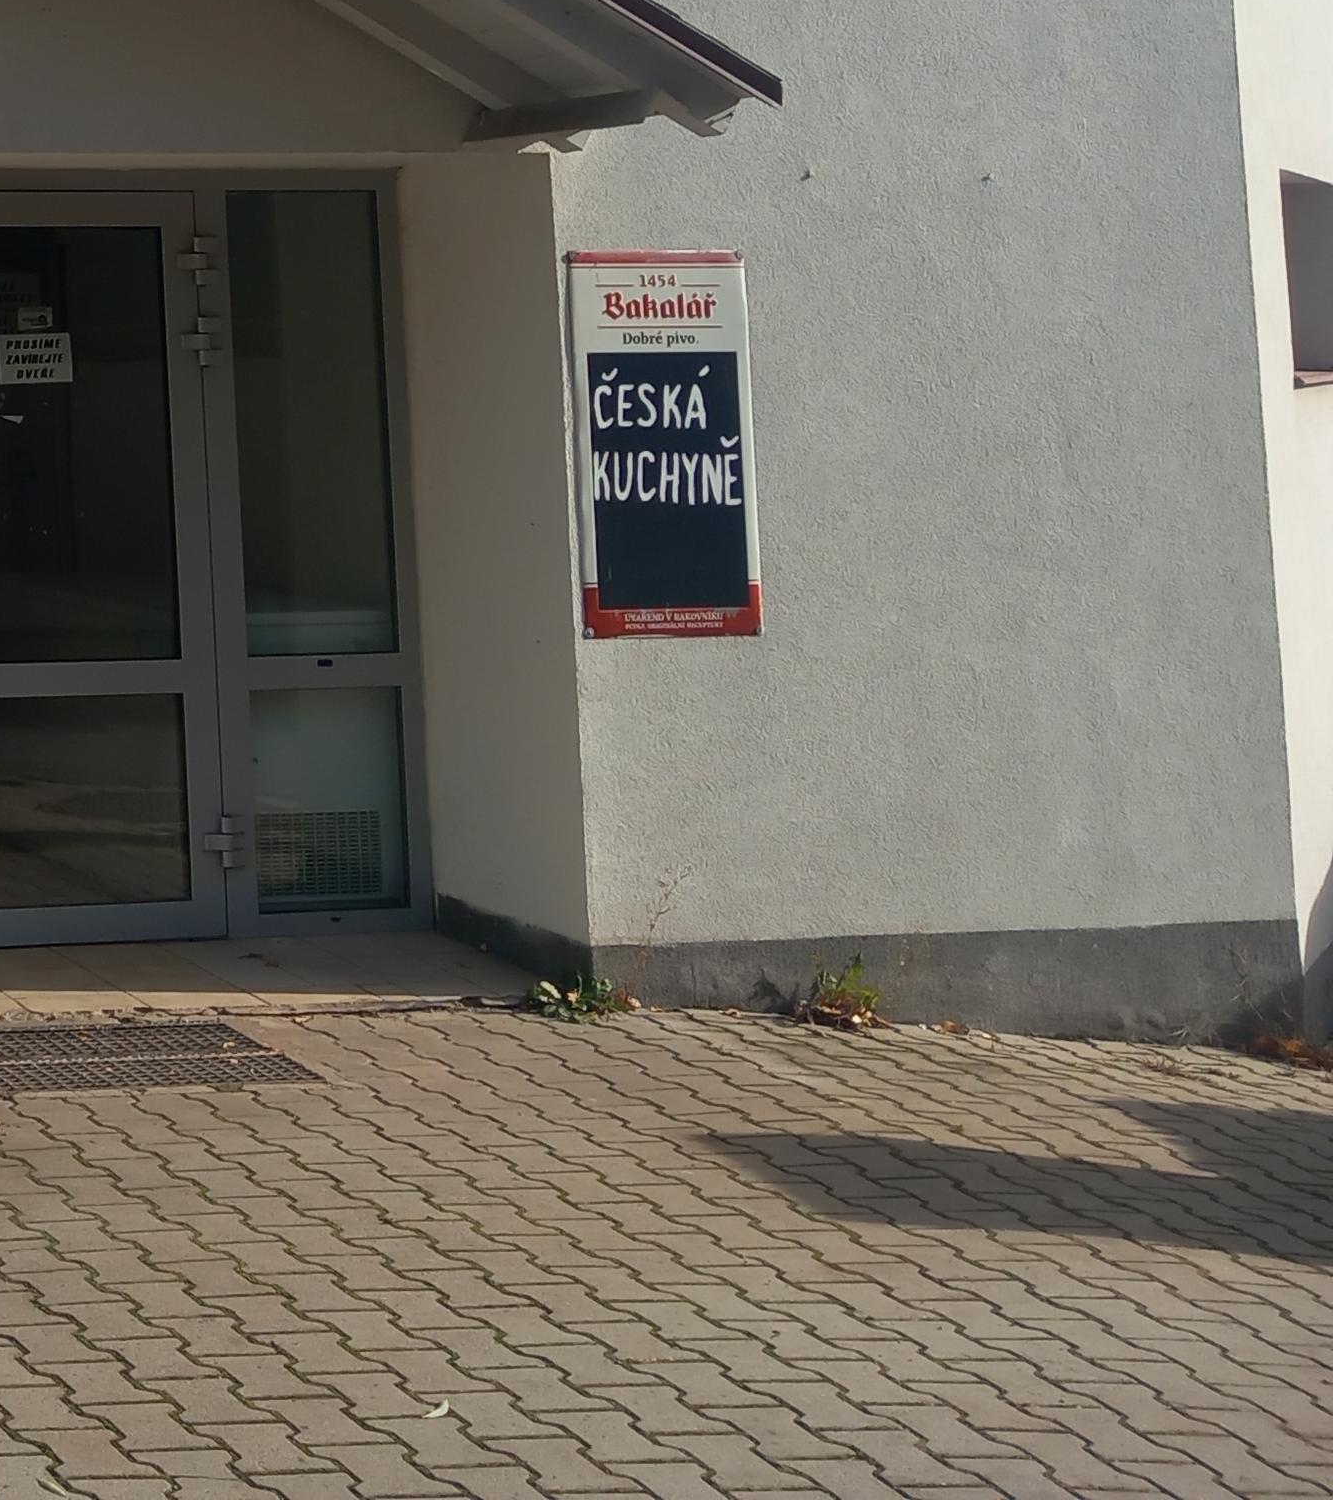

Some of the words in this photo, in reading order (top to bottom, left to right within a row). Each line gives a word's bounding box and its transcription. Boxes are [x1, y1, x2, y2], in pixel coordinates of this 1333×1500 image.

[638, 273, 677, 288] 1454
[601, 290, 718, 321] Bakalář
[622, 330, 663, 346] Dobré
[666, 331, 700, 348] pivo.
[592, 364, 711, 431] ČESKÁ
[591, 434, 743, 506] KUCHYNĚ
